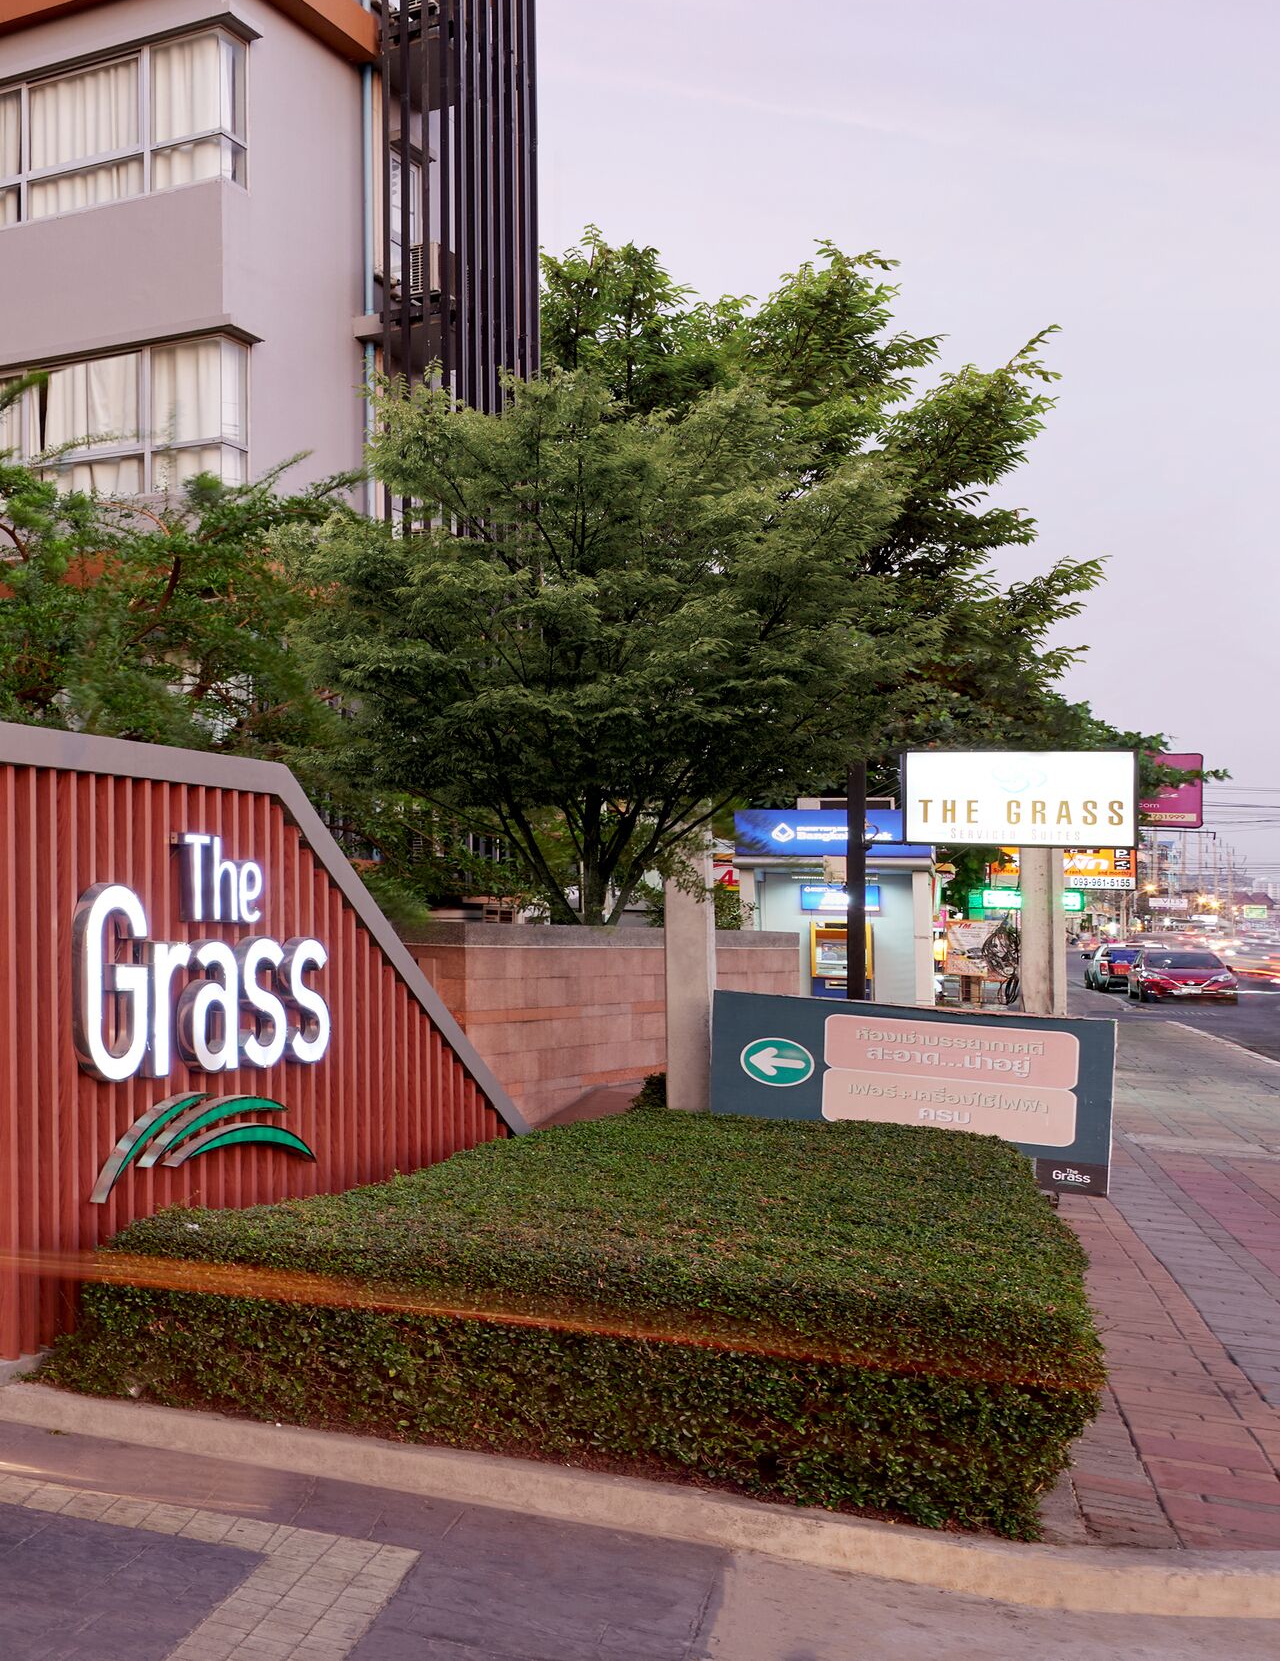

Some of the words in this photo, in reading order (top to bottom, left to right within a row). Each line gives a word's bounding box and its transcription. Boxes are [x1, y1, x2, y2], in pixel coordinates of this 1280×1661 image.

[918, 799, 979, 823] THE
[1006, 799, 1124, 826] GRASS
[183, 833, 263, 923] The
[1073, 877, 1131, 888] 093-961-5155
[74, 882, 330, 1082] Grass
[918, 1107, 972, 1125] ครบ
[1052, 1169, 1091, 1183] Grass
